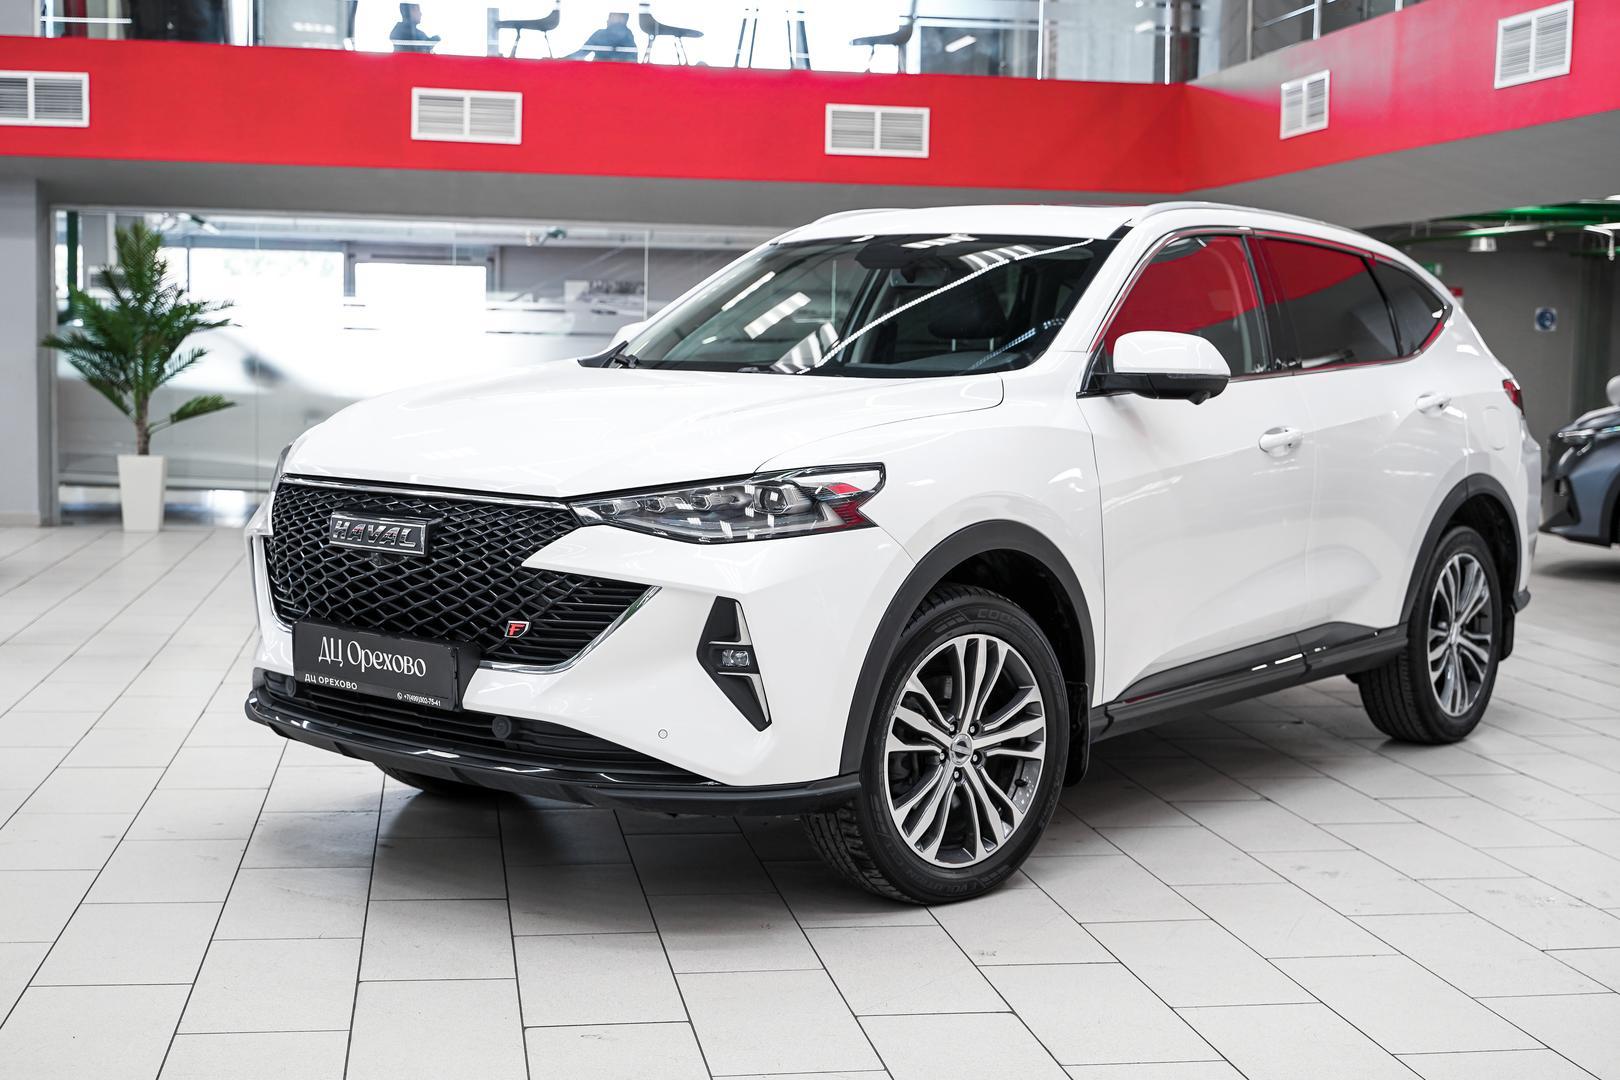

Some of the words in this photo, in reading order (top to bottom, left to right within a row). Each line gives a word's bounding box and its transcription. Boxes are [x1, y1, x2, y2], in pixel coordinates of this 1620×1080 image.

[333, 521, 415, 548] HAVAL
[508, 622, 524, 636] F
[318, 636, 344, 667] ДЦ
[347, 640, 427, 677] Орехово
[304, 673, 317, 684] ДЦ
[318, 675, 358, 690] ОРЕХОВО
